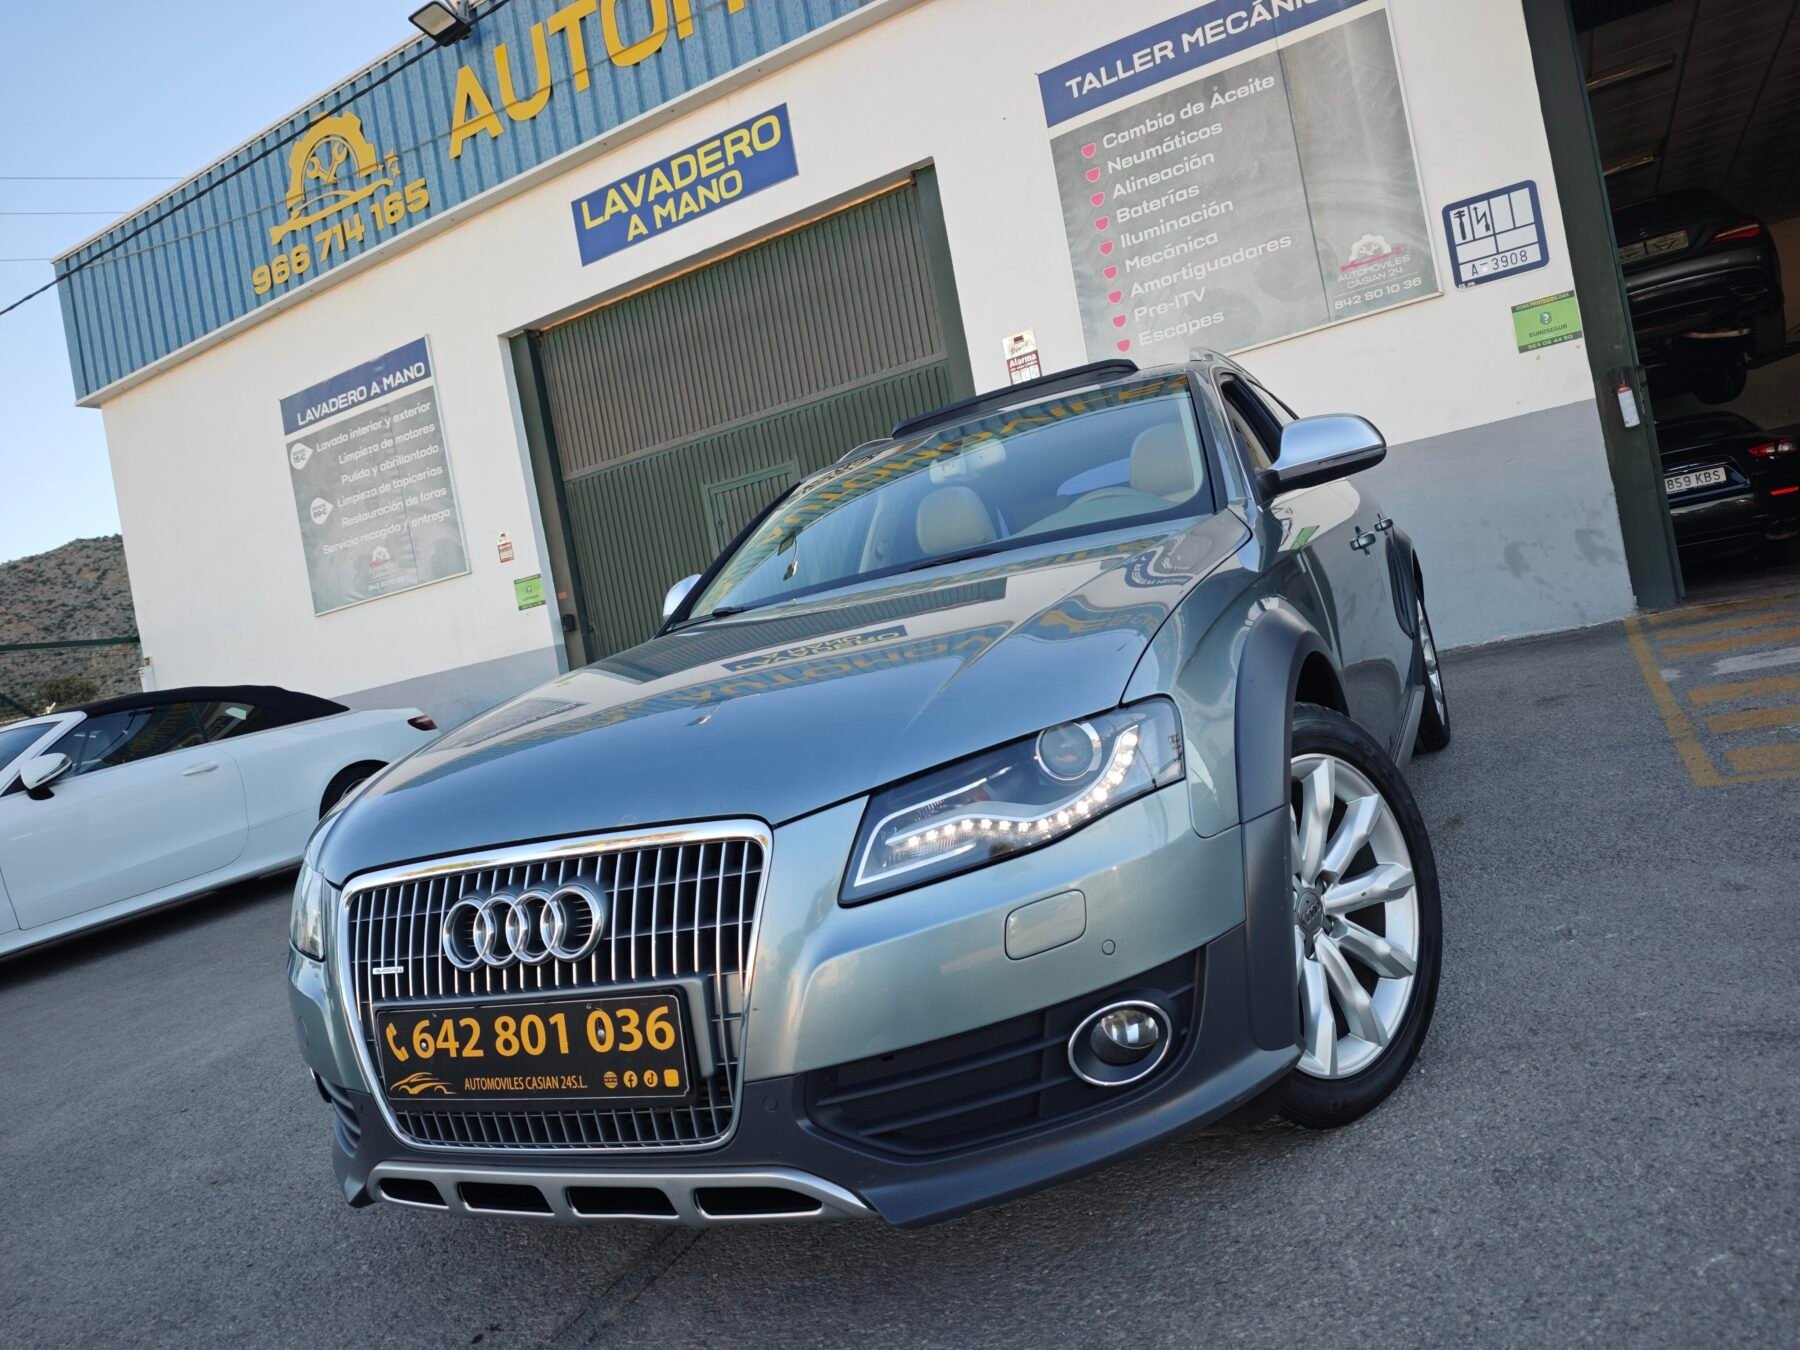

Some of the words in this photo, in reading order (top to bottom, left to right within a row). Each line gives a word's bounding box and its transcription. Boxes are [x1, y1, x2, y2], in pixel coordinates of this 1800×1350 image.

[1065, 40, 1174, 99] TALLER
[1181, 0, 1319, 53] MECÁN
[449, 0, 746, 160] AUTO
[1103, 112, 1175, 149] Cambio
[1180, 99, 1205, 120] de
[1210, 75, 1276, 109] Aceite
[1108, 122, 1223, 174] Neumáticos
[581, 114, 782, 230] LAVADERO
[1113, 152, 1215, 199] Alineación
[627, 213, 648, 241] A
[653, 170, 743, 228] MANO
[1116, 184, 1200, 224] Baterías
[1121, 200, 1234, 248] Iluminación
[252, 244, 311, 295] 966
[315, 213, 365, 261] 714
[370, 178, 430, 231] 165
[1125, 231, 1218, 272] Mecánica
[1130, 235, 1292, 298] Amortiguadores
[1346, 271, 1386, 289] CASIAN
[1134, 287, 1206, 322] Pre-ITV
[1334, 295, 1362, 310] 642
[1364, 288, 1383, 301] 80
[1385, 283, 1400, 294] 10
[1403, 277, 1422, 289] 36
[1138, 311, 1225, 346] Escapes
[1529, 323, 1568, 338] EUROSEGUR
[1010, 353, 1037, 368] Alarma
[297, 386, 367, 426] LAVADERO
[370, 382, 380, 396] A
[382, 362, 425, 391] MANO
[316, 434, 348, 452] Lavado
[350, 420, 387, 439] interior
[386, 417, 392, 429] y
[393, 401, 431, 422] exterior
[338, 444, 379, 464] Limpieza
[381, 438, 393, 449] de
[395, 423, 435, 444] motores
[341, 469, 371, 485] Pulido
[371, 467, 378, 477] y
[380, 445, 439, 471] abrillantado
[1695, 469, 1721, 485] KBS
[337, 487, 378, 508] Limpieza
[379, 483, 391, 494] de
[342, 501, 403, 527] Restauración
[405, 494, 418, 506] de
[420, 486, 447, 502] faros
[322, 535, 359, 555] Servicio
[360, 523, 400, 543] recogida
[411, 508, 450, 528] entrega
[412, 1017, 484, 1059] 642
[494, 1013, 569, 1056] 801
[586, 1006, 676, 1052] 036
[464, 1075, 524, 1091] AUTOMOVILES
[526, 1074, 559, 1089] CASIAN
